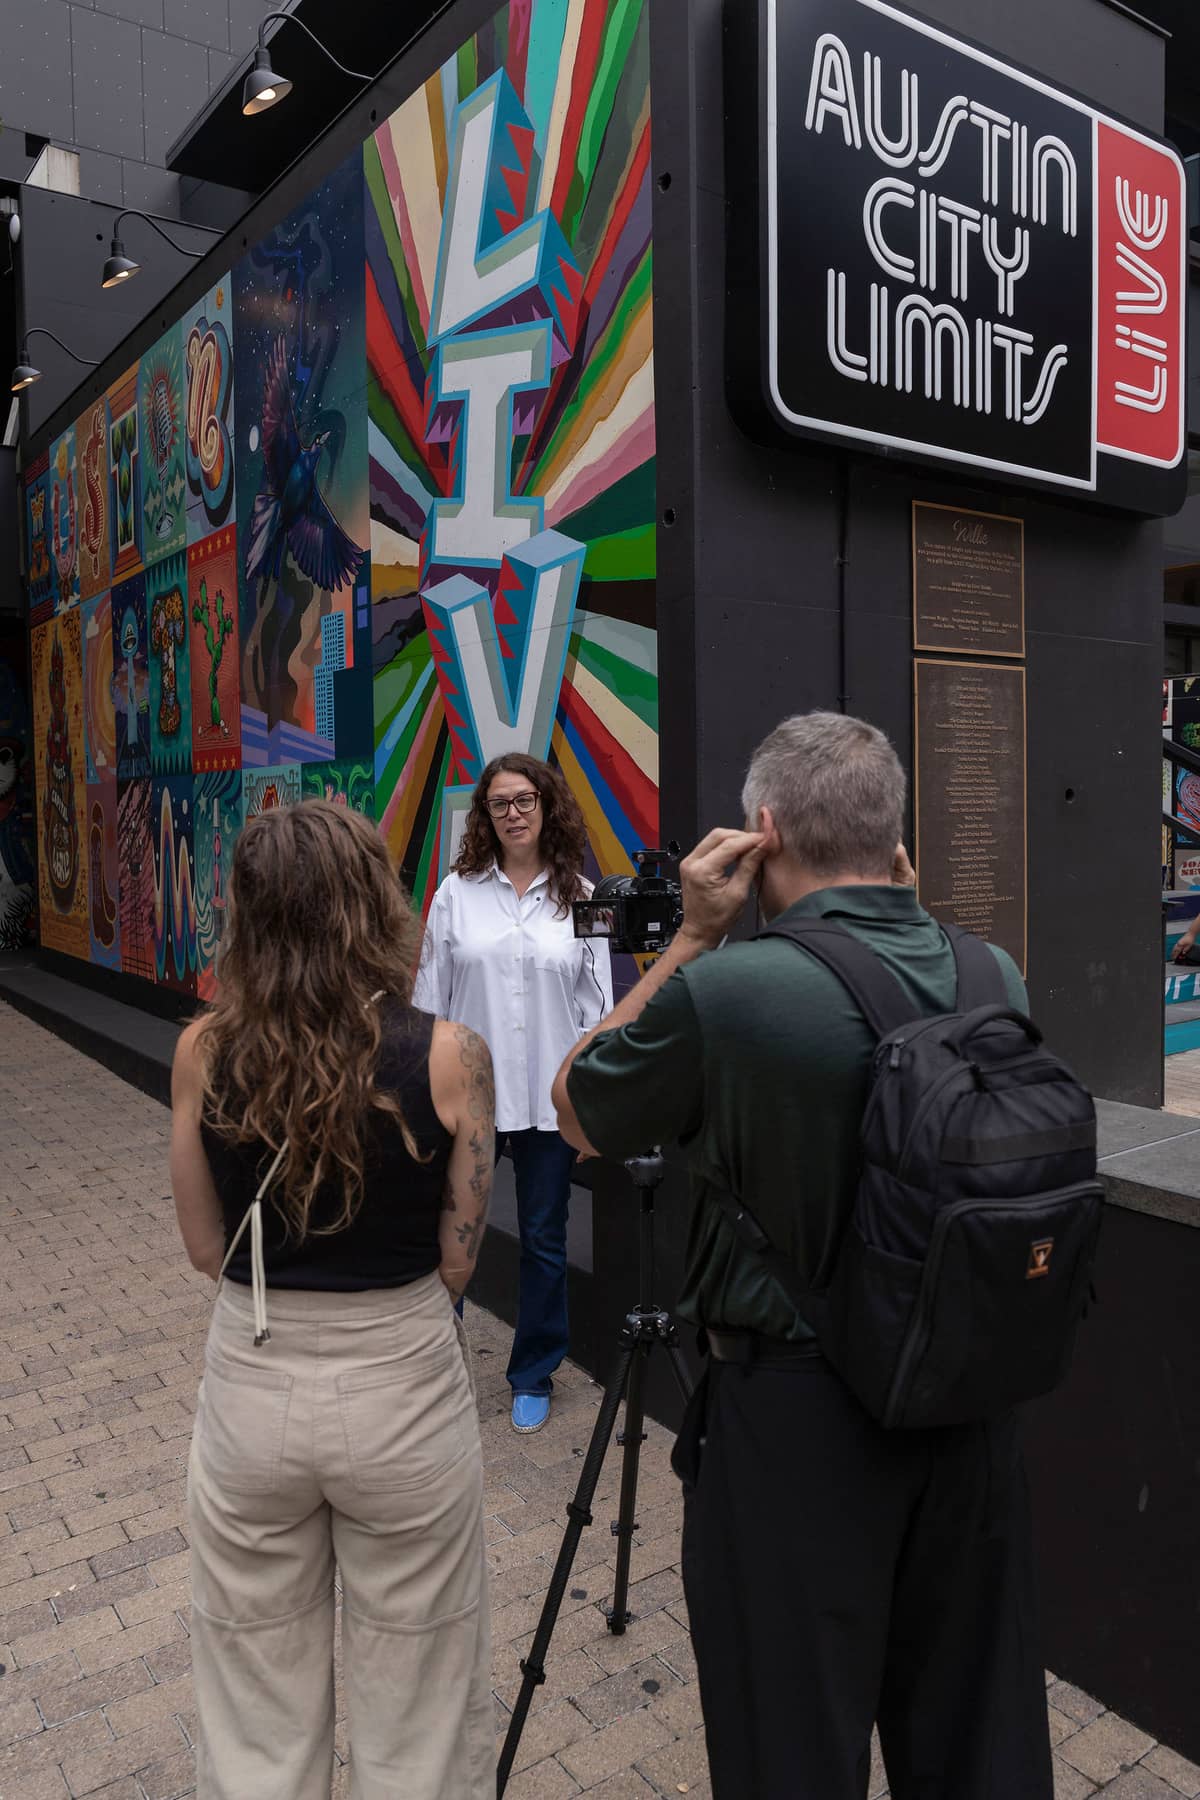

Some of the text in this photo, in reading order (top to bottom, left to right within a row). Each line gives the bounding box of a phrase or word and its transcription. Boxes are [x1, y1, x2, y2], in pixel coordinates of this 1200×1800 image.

[805, 33, 1077, 237] AUSTIN
[863, 177, 1030, 317] CITY
[827, 268, 1068, 424] LIMITS
[420, 65, 588, 892] LIV
